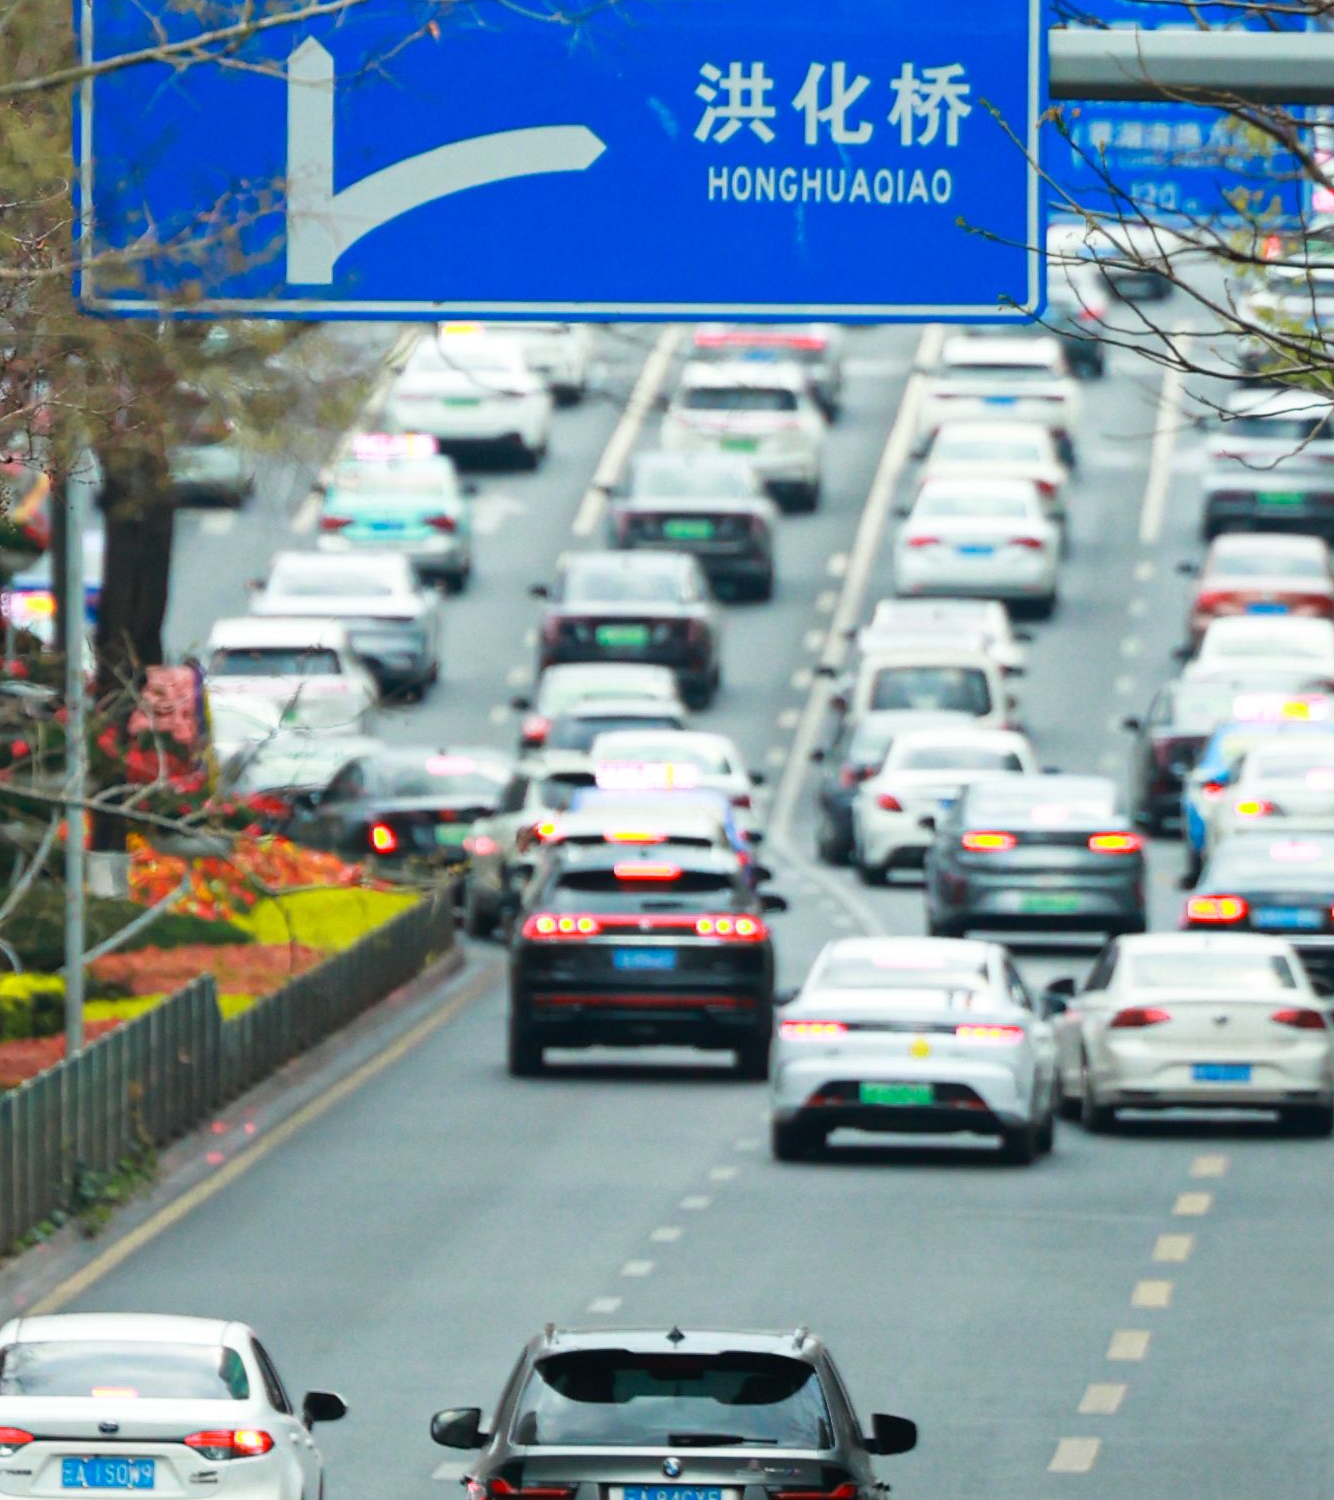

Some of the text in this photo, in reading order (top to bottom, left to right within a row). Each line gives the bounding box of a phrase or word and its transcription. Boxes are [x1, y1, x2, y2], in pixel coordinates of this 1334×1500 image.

[693, 61, 972, 147] 洪化桥
[708, 166, 953, 204] HONGHUAQIAO
